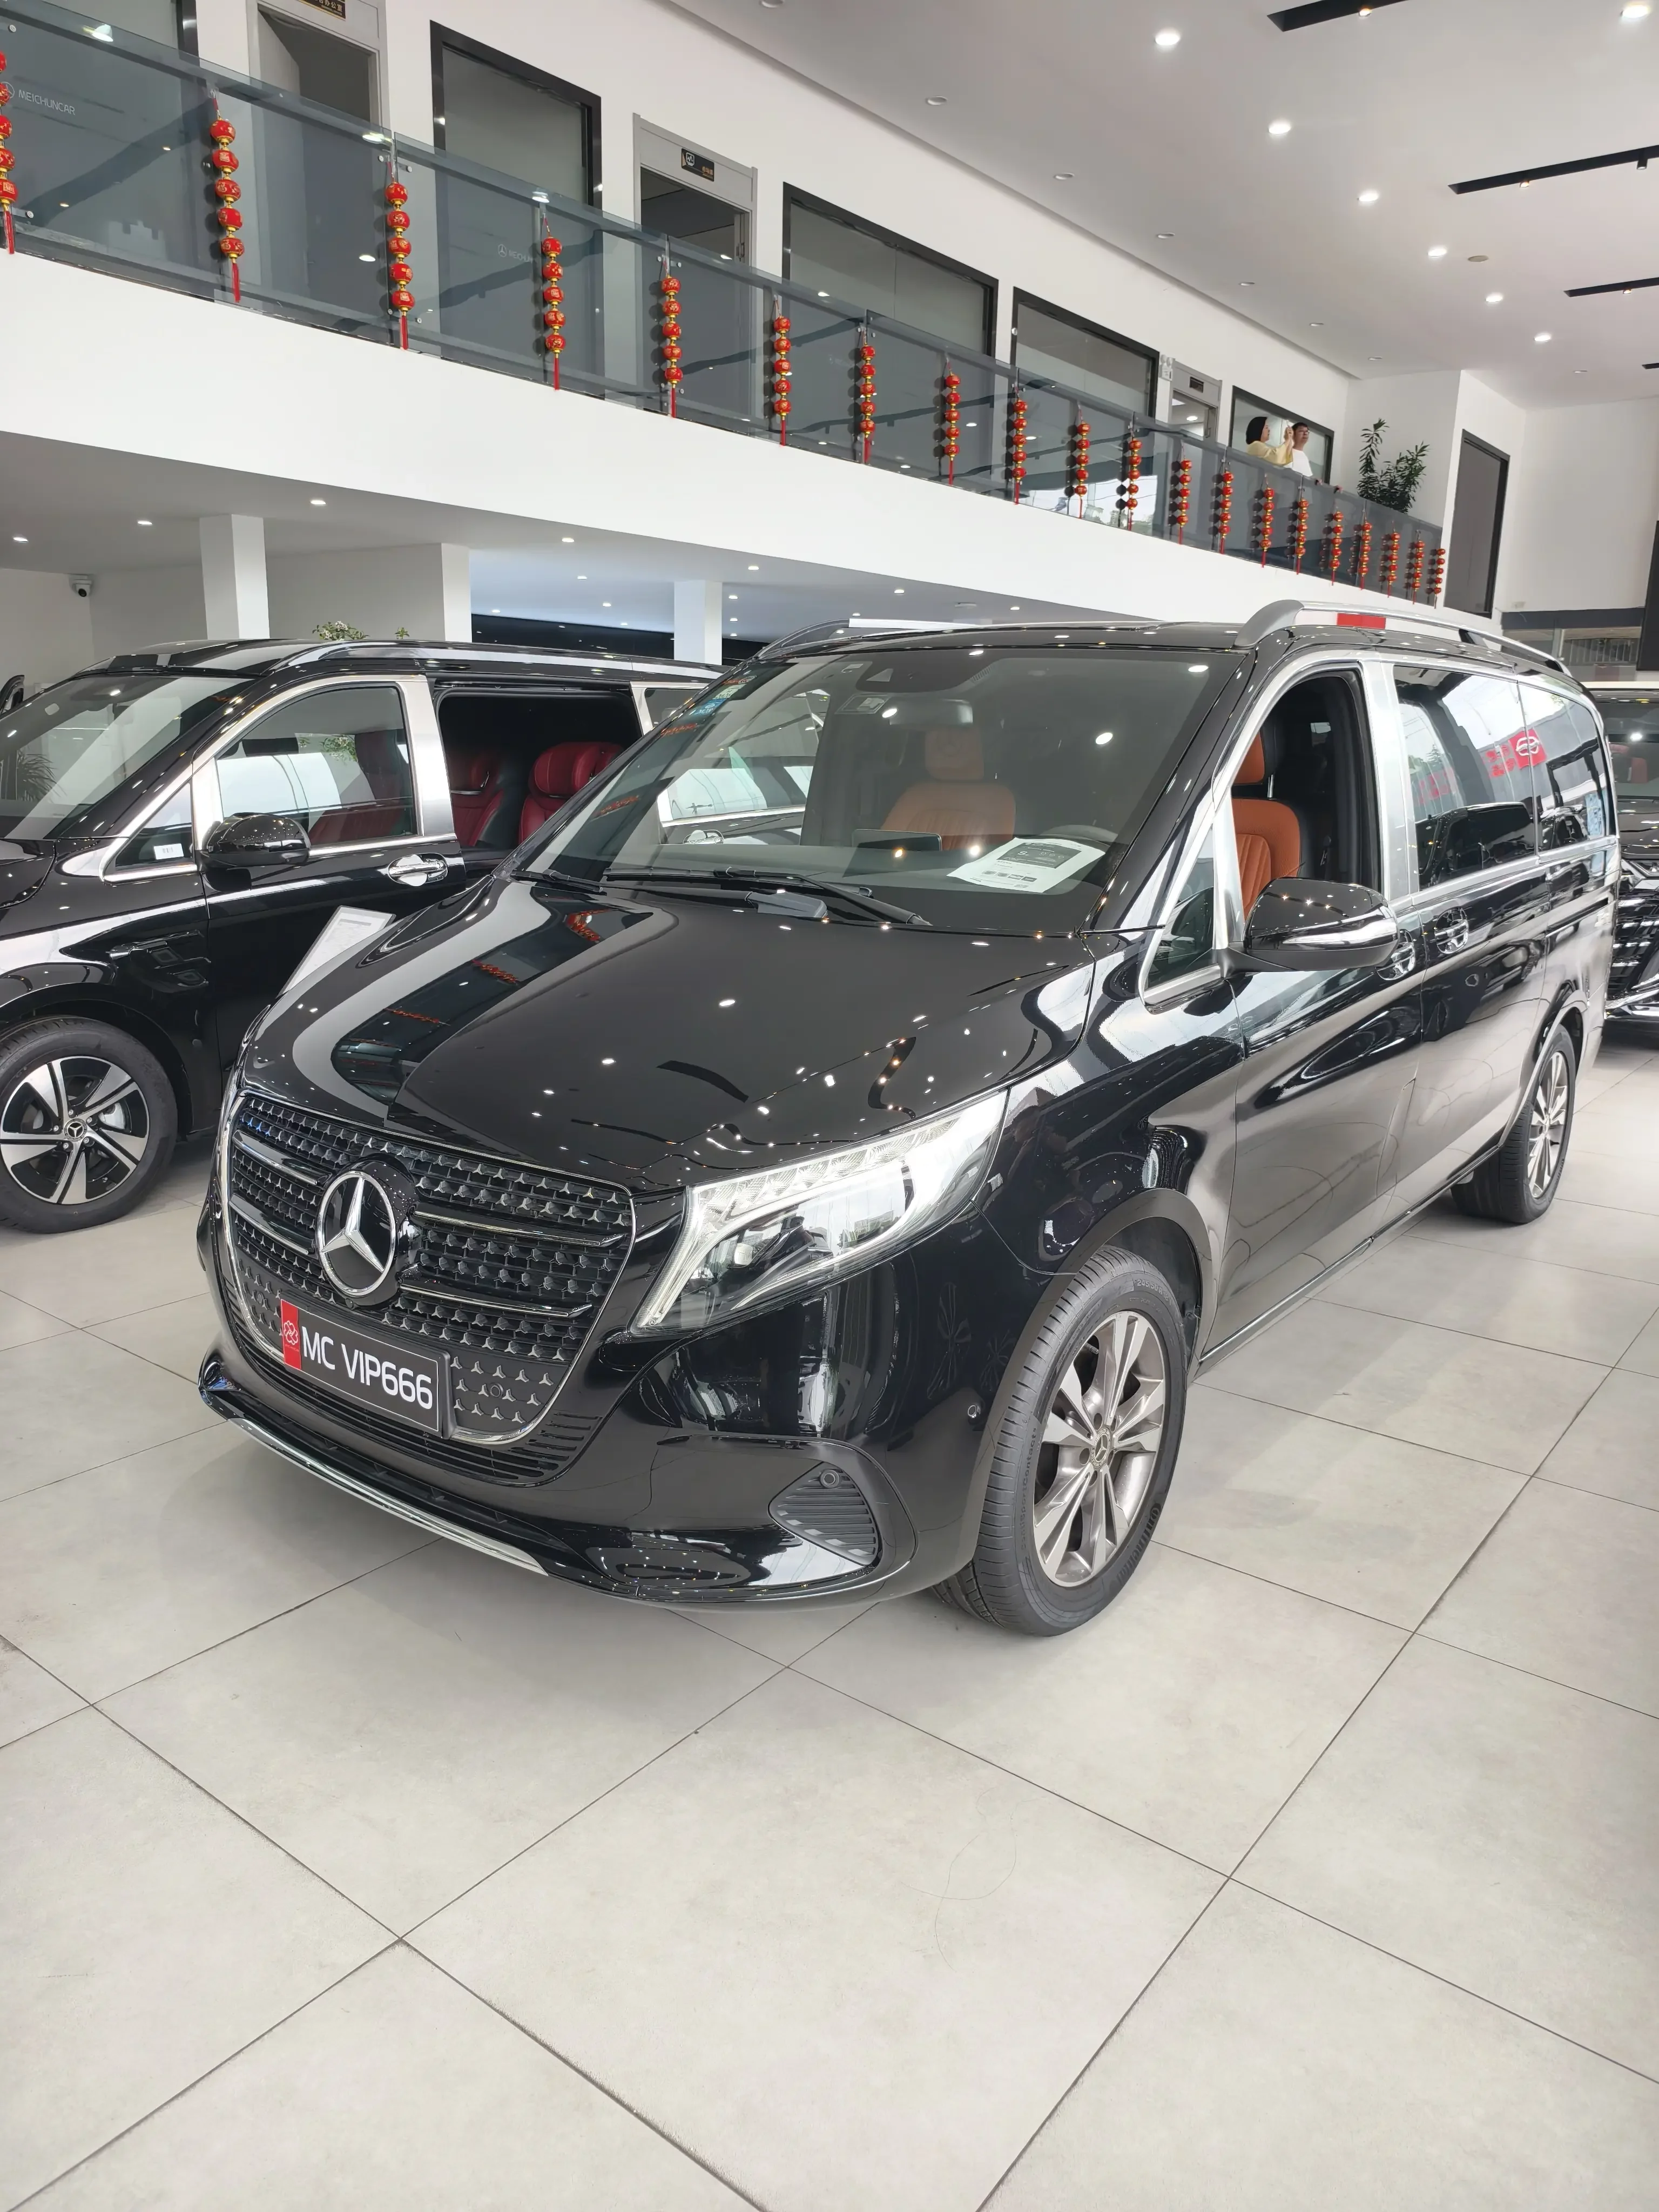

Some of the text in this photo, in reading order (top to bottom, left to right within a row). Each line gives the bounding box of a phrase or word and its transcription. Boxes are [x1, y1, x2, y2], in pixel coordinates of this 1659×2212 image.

[18, 89, 76, 116] MEICHUNCAR
[301, 1326, 433, 1410] MC VIP666
